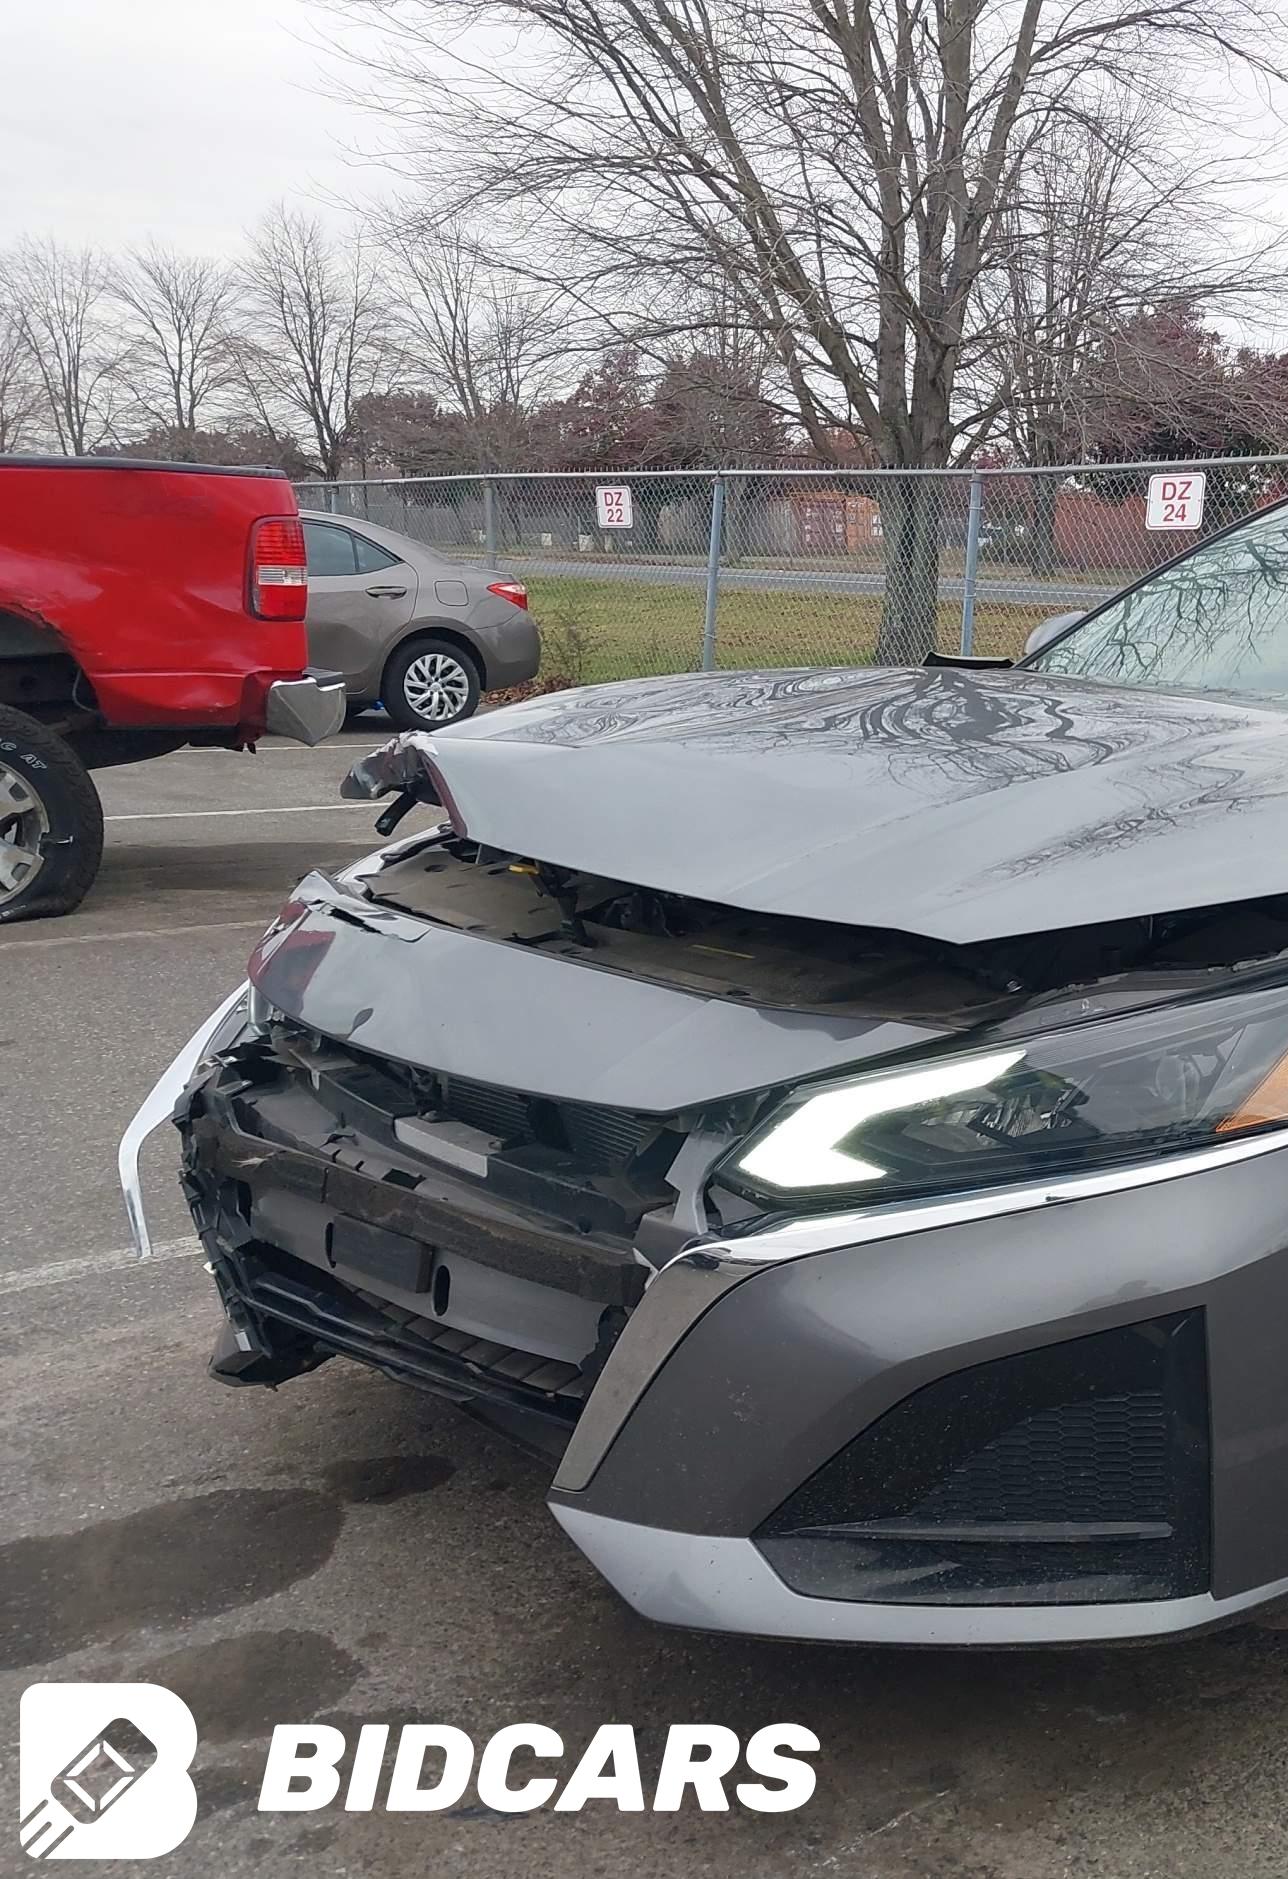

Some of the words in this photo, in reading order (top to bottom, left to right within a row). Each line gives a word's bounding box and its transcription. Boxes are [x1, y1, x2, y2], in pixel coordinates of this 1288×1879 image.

[1161, 480, 1193, 501] DZ
[603, 491, 624, 507] DZ
[607, 508, 624, 523] 22
[1162, 503, 1187, 522] 24
[20, 753, 48, 769] AT
